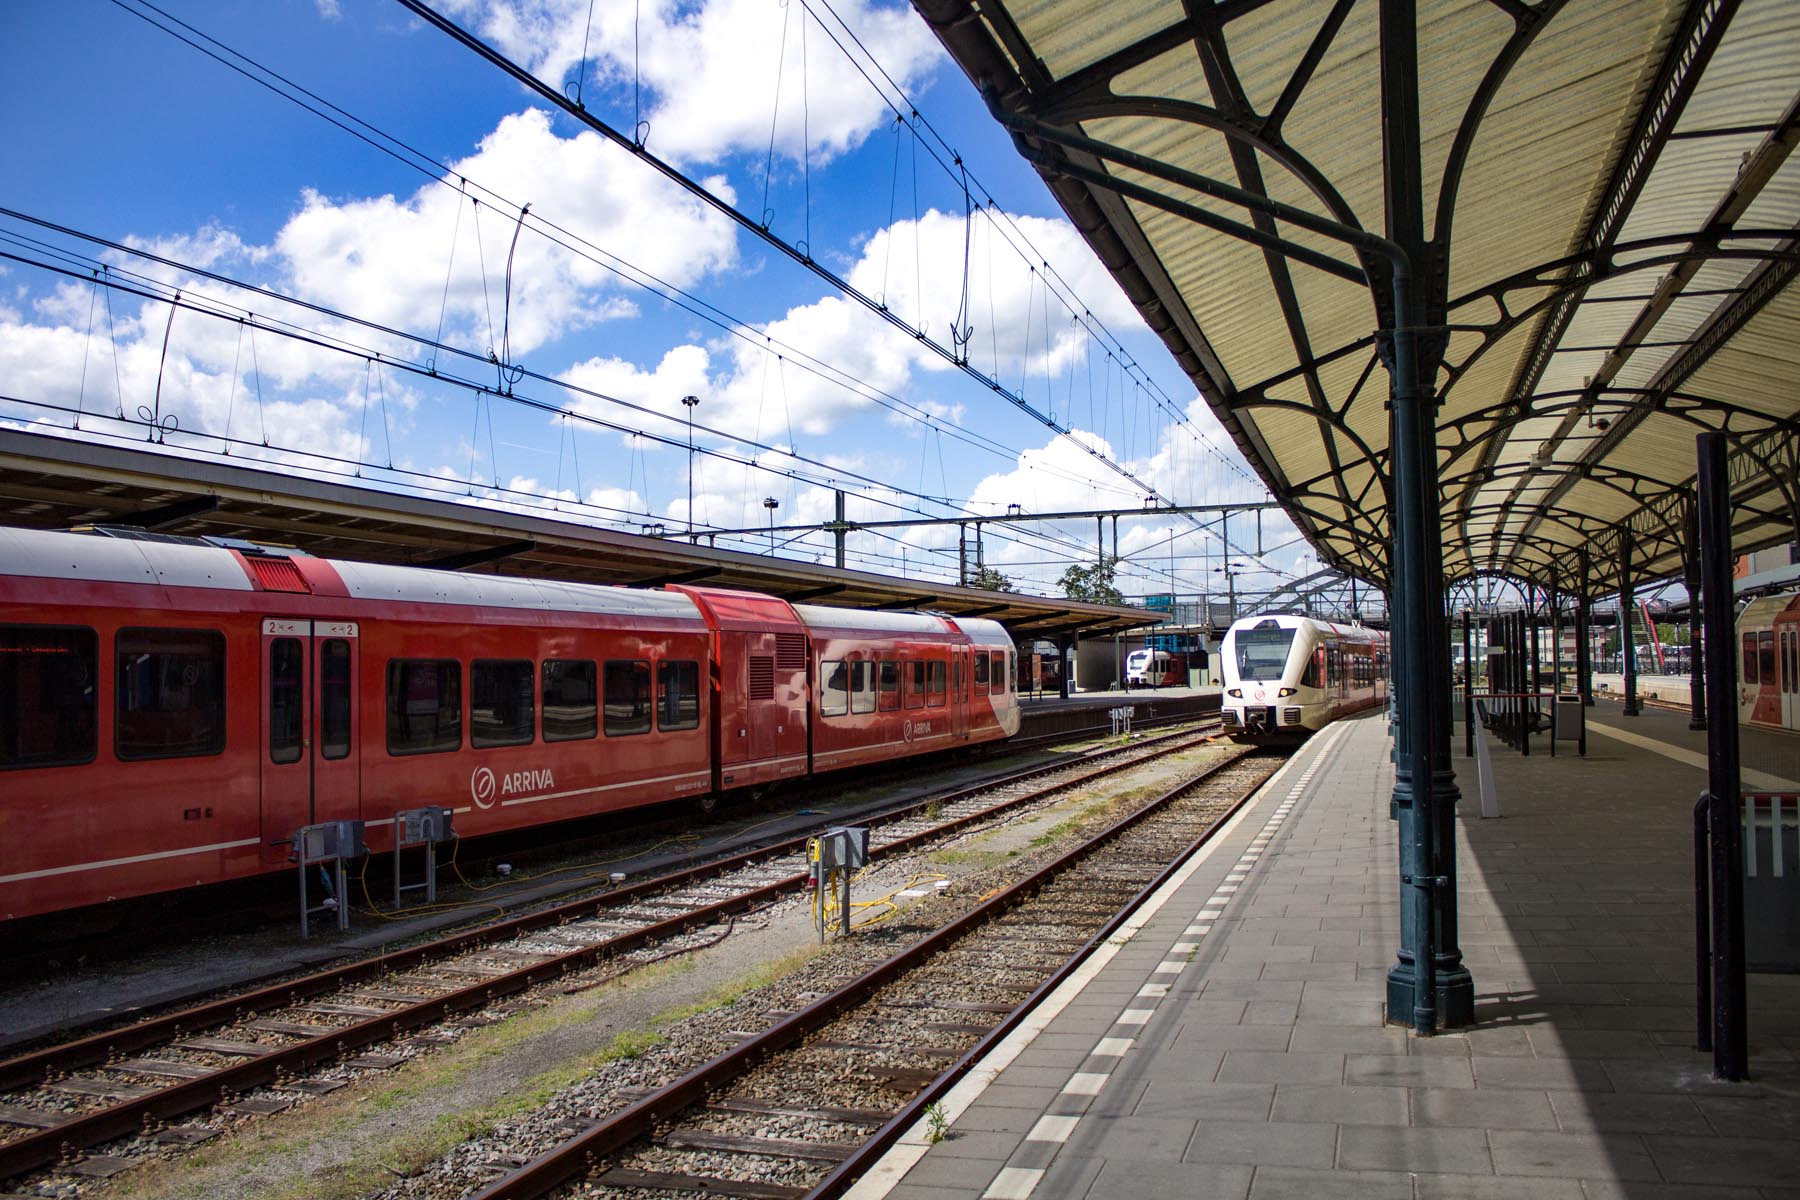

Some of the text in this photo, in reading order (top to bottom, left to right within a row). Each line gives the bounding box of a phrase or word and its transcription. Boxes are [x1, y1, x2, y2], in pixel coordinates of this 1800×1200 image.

[269, 622, 276, 633] 2
[347, 625, 353, 635] 2
[913, 722, 932, 736] ARRIVA
[501, 768, 555, 795] ARRIVA
